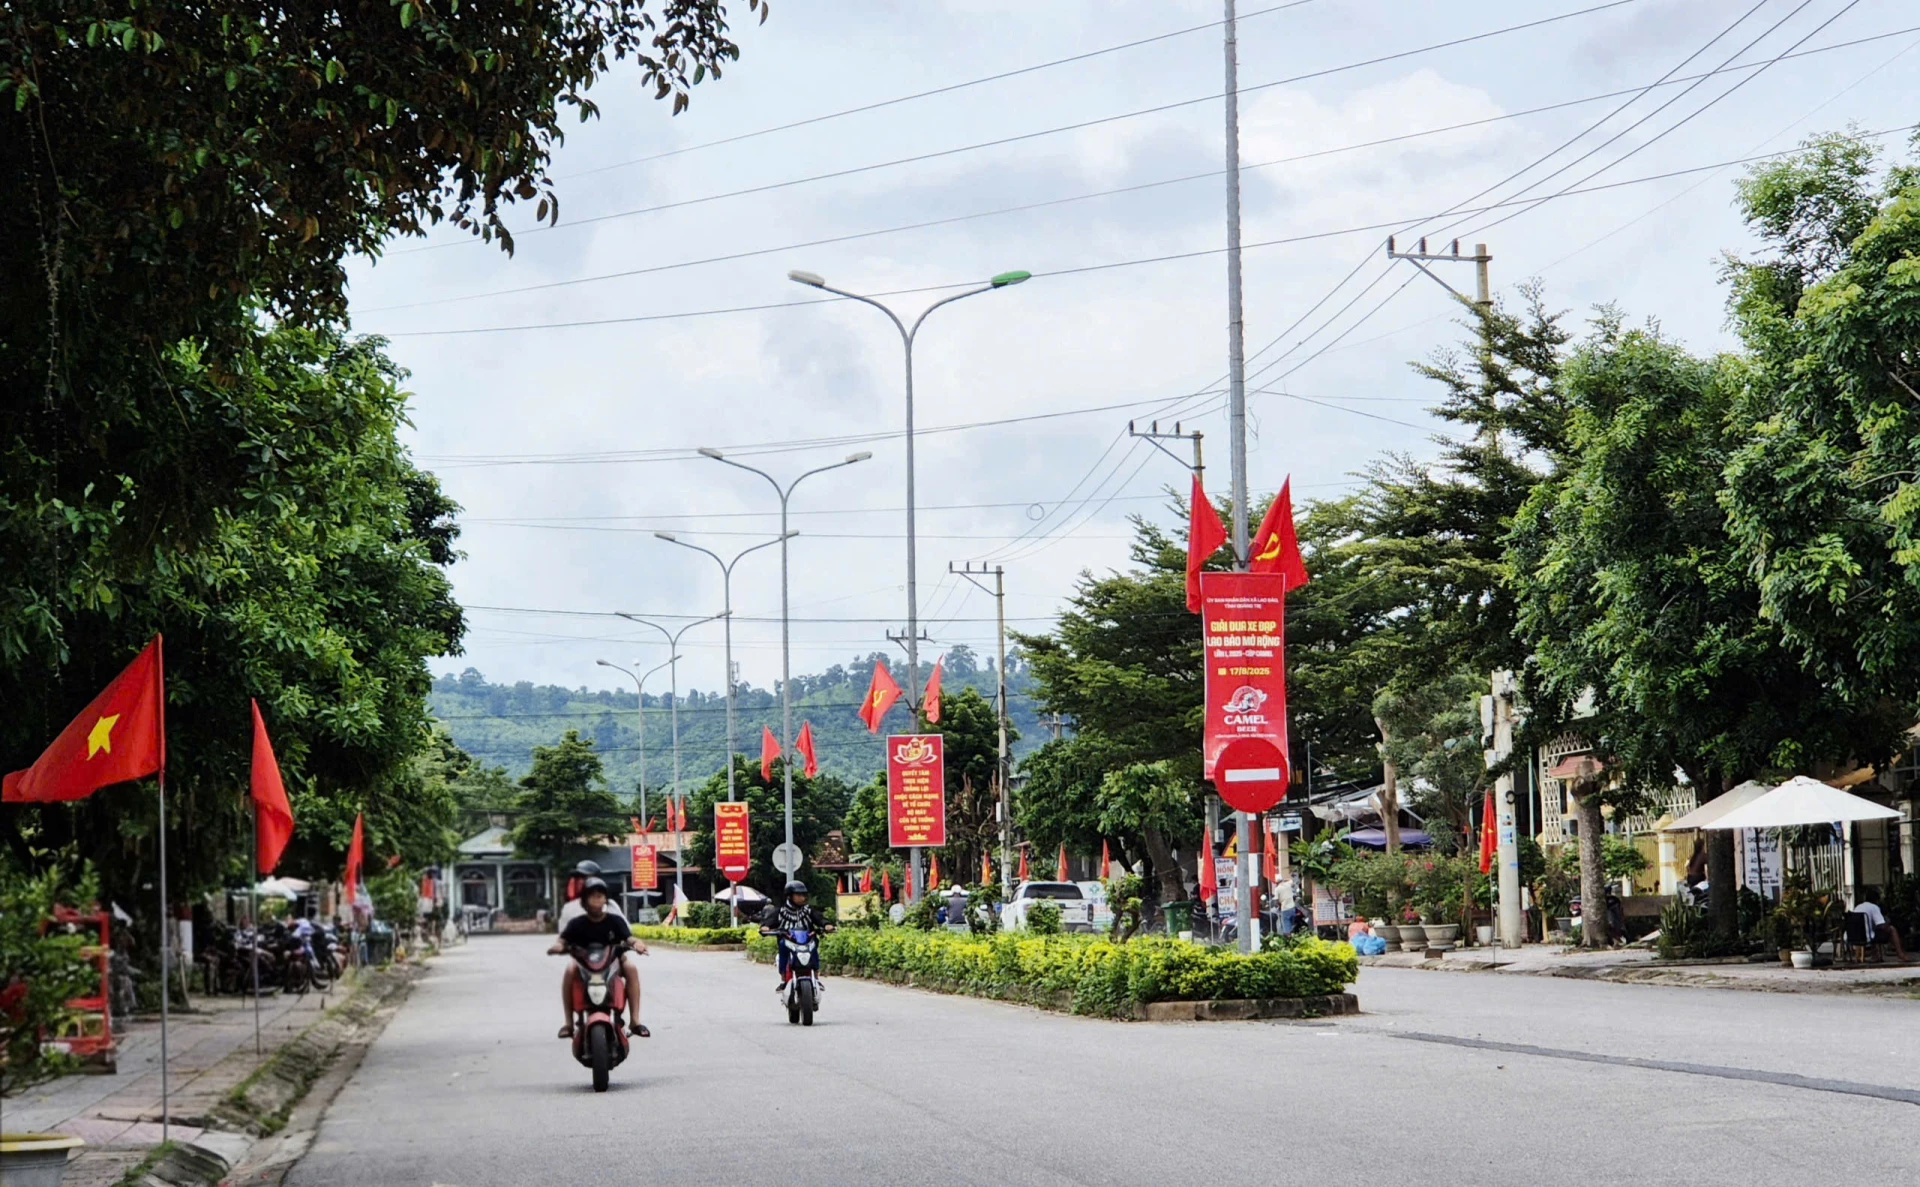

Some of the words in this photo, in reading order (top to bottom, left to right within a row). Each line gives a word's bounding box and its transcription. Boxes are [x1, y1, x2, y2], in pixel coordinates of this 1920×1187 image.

[1211, 618, 1228, 632] GIẢI
[1247, 621, 1257, 632] XE
[1258, 621, 1276, 633] ĐẠP
[1207, 636, 1222, 646] LAO
[1224, 634, 1241, 646] BẢO
[1258, 634, 1280, 648] RỘNG
[1230, 666, 1270, 676] 17/8/2025
[1224, 715, 1268, 725] CAMEL
